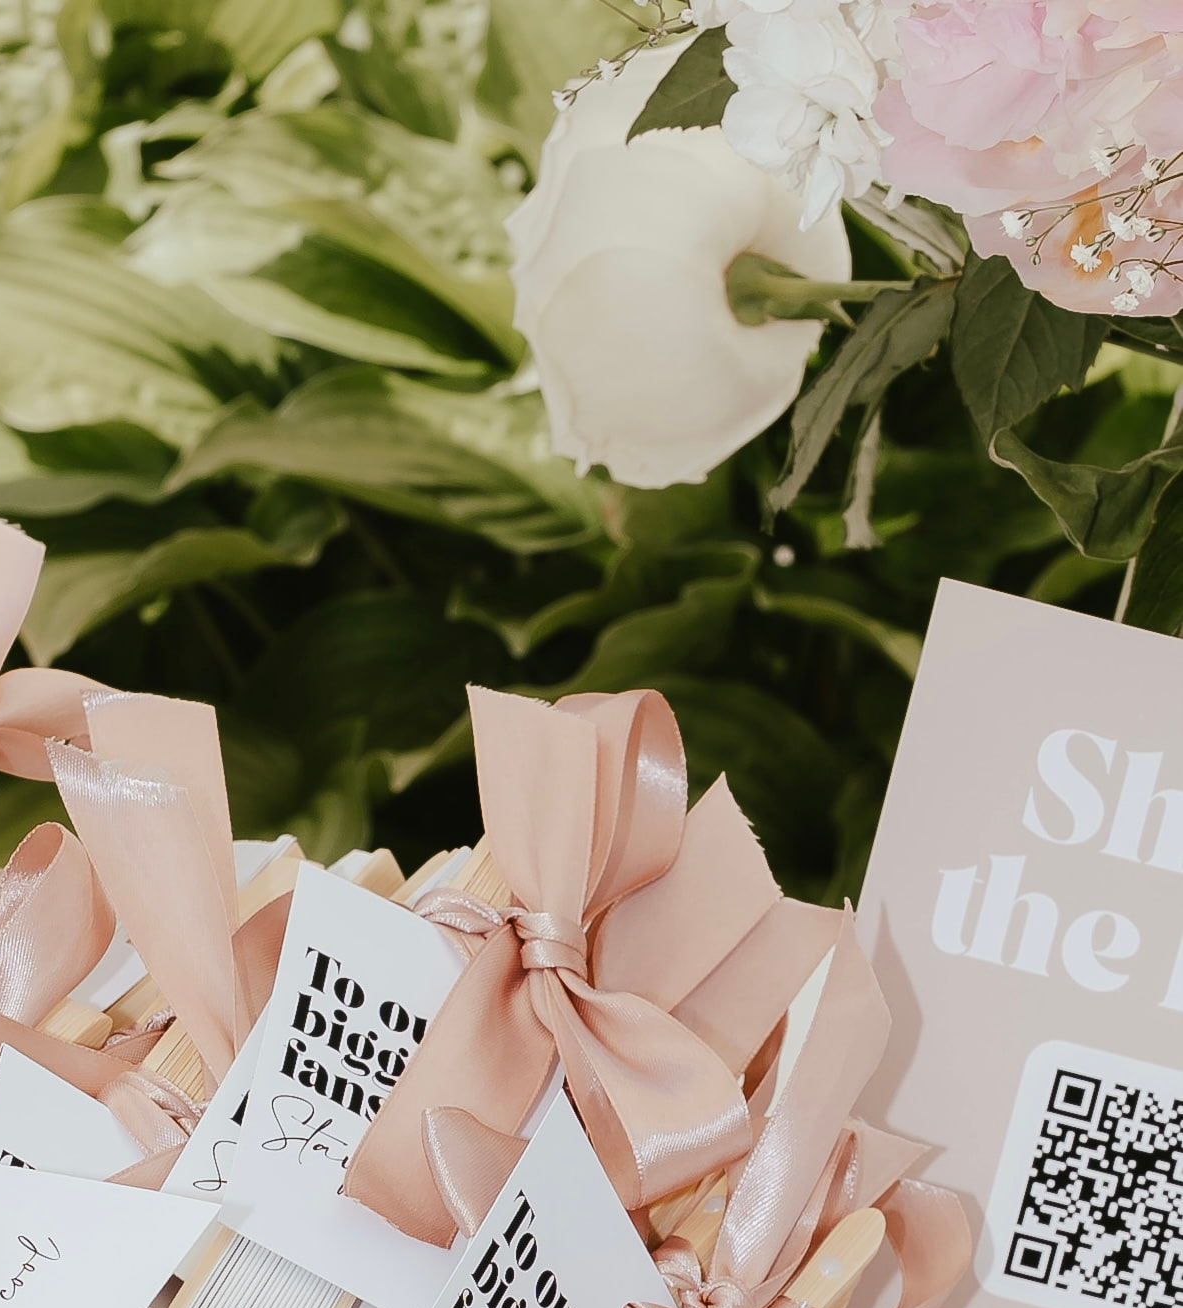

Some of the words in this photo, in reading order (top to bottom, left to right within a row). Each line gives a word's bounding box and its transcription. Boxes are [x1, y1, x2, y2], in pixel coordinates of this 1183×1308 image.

[1022, 728, 1183, 874] Sh
[931, 854, 1141, 992] the
[304, 946, 365, 1009] To
[291, 991, 410, 1093] bigg
[0, 1235, 61, 1300] cool
[502, 1189, 538, 1272] To
